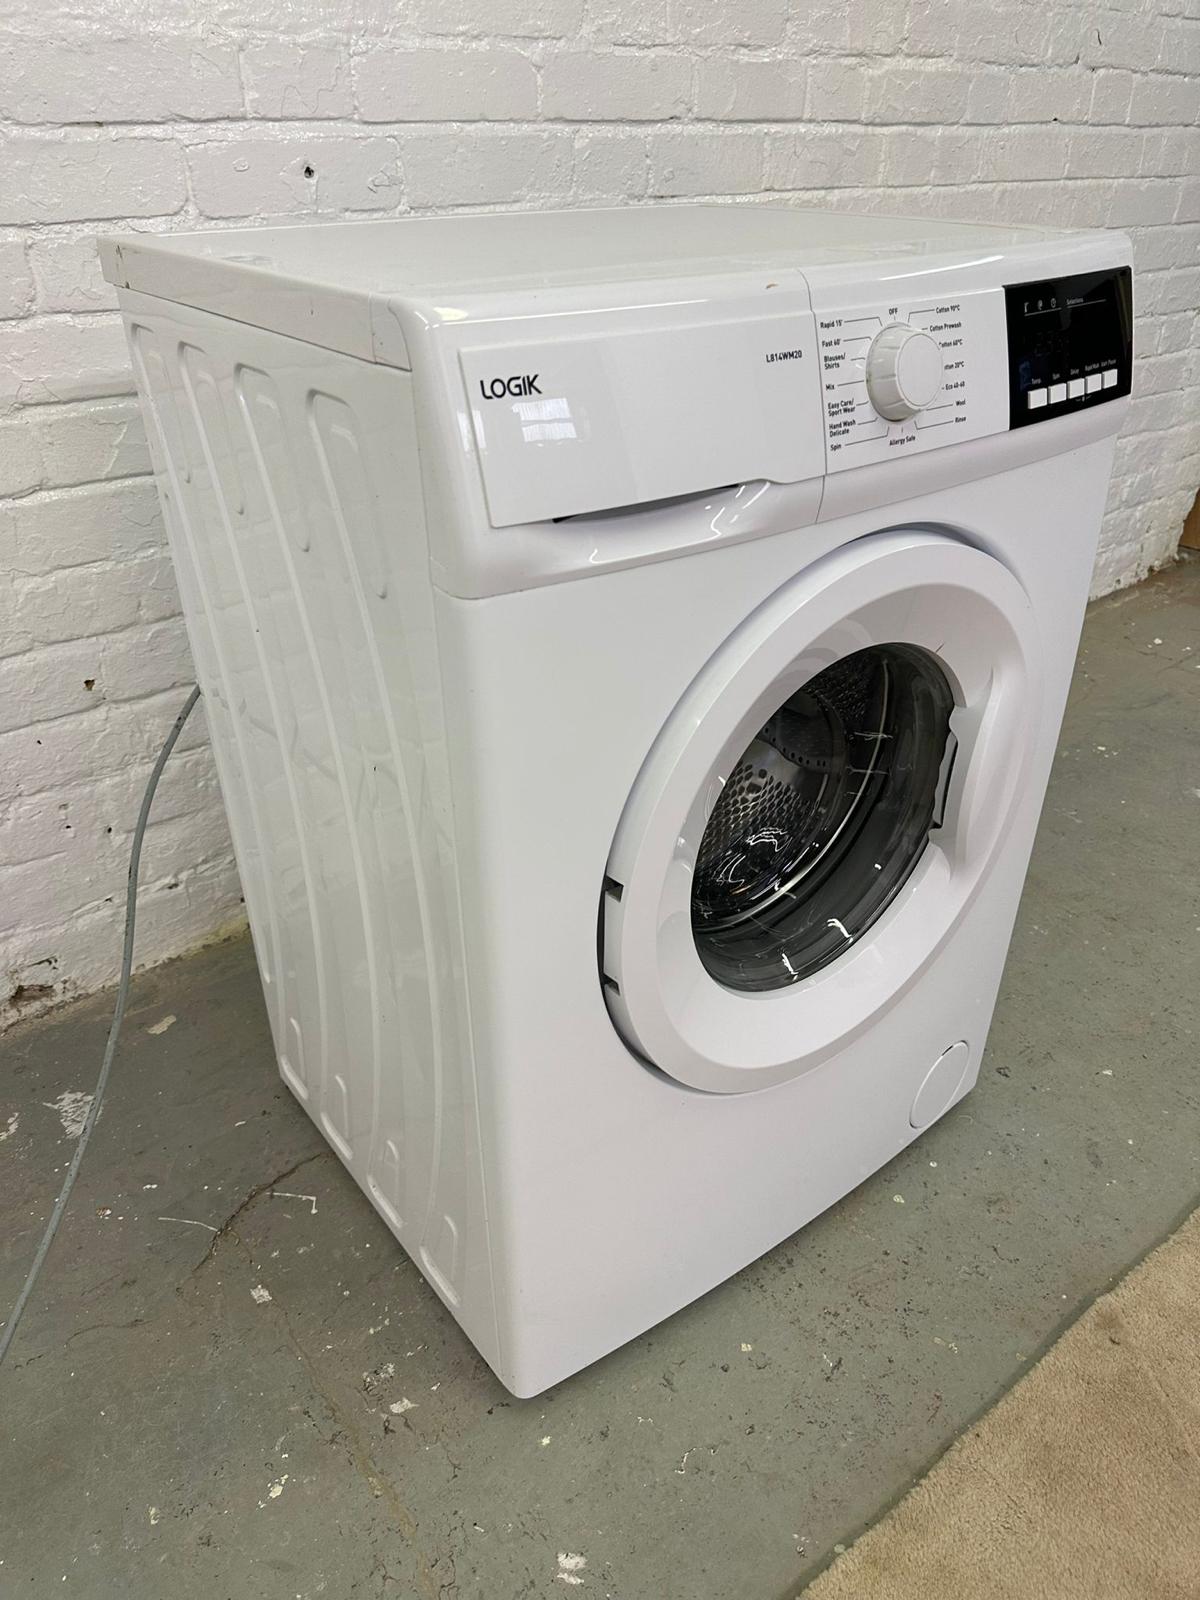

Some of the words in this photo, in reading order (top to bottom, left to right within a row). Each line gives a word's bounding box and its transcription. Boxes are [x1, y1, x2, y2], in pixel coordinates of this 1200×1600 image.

[888, 307, 898, 316] OFF
[820, 320, 835, 329] Rapid
[766, 350, 802, 362] L814WM20
[824, 352, 846, 362] Blouses/
[824, 362, 840, 370] Shirts
[480, 374, 542, 400] LOGIK
[840, 398, 854, 407] Care/
[956, 398, 966, 406] Wool
[828, 409, 842, 417] Sport
[829, 422, 842, 430] Hand
[842, 420, 856, 428] Wash
[830, 428, 850, 438] Delicate
[889, 438, 906, 446] Allergy
[830, 444, 842, 452] Spin
